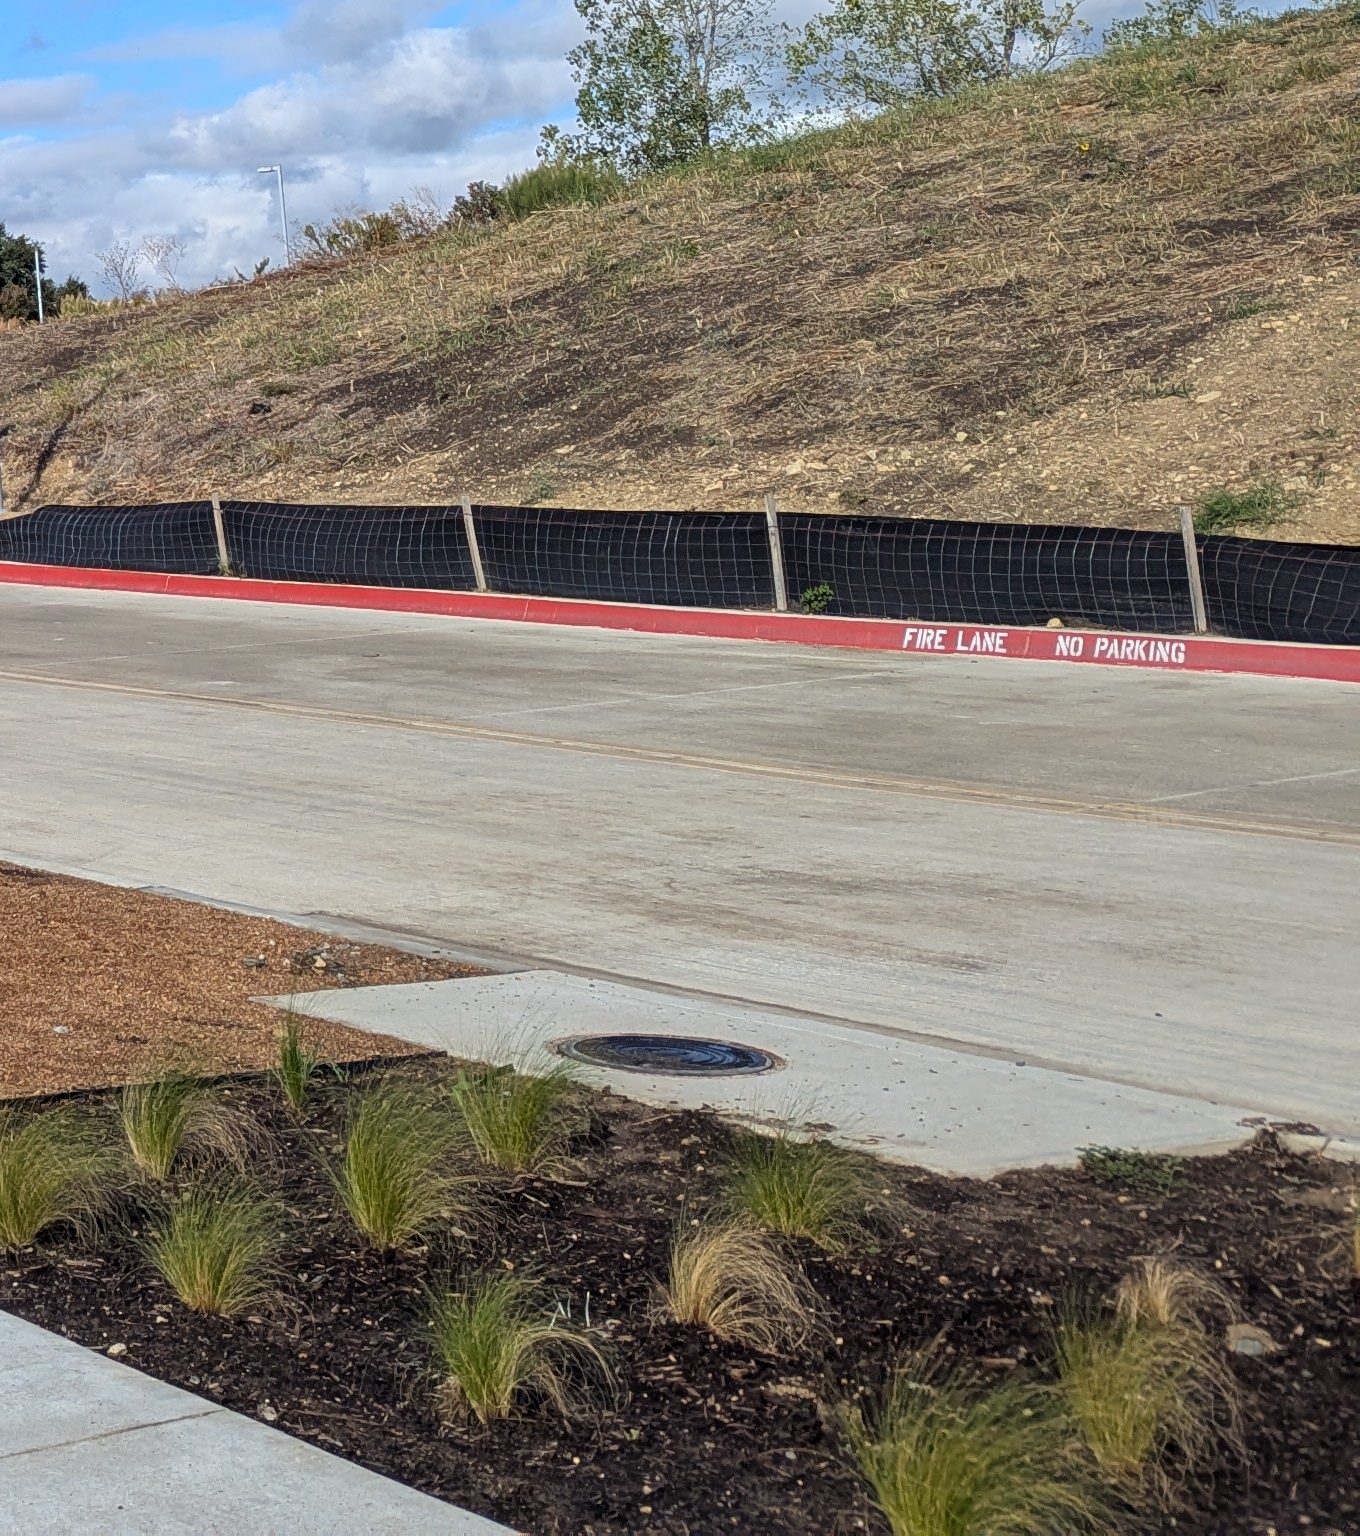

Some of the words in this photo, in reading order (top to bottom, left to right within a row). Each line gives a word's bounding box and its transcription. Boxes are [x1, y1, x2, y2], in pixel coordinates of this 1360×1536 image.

[902, 627, 948, 650] FIRE
[956, 630, 1009, 654] LANE
[1055, 635, 1084, 657] NO
[1093, 637, 1186, 664] PARKING
